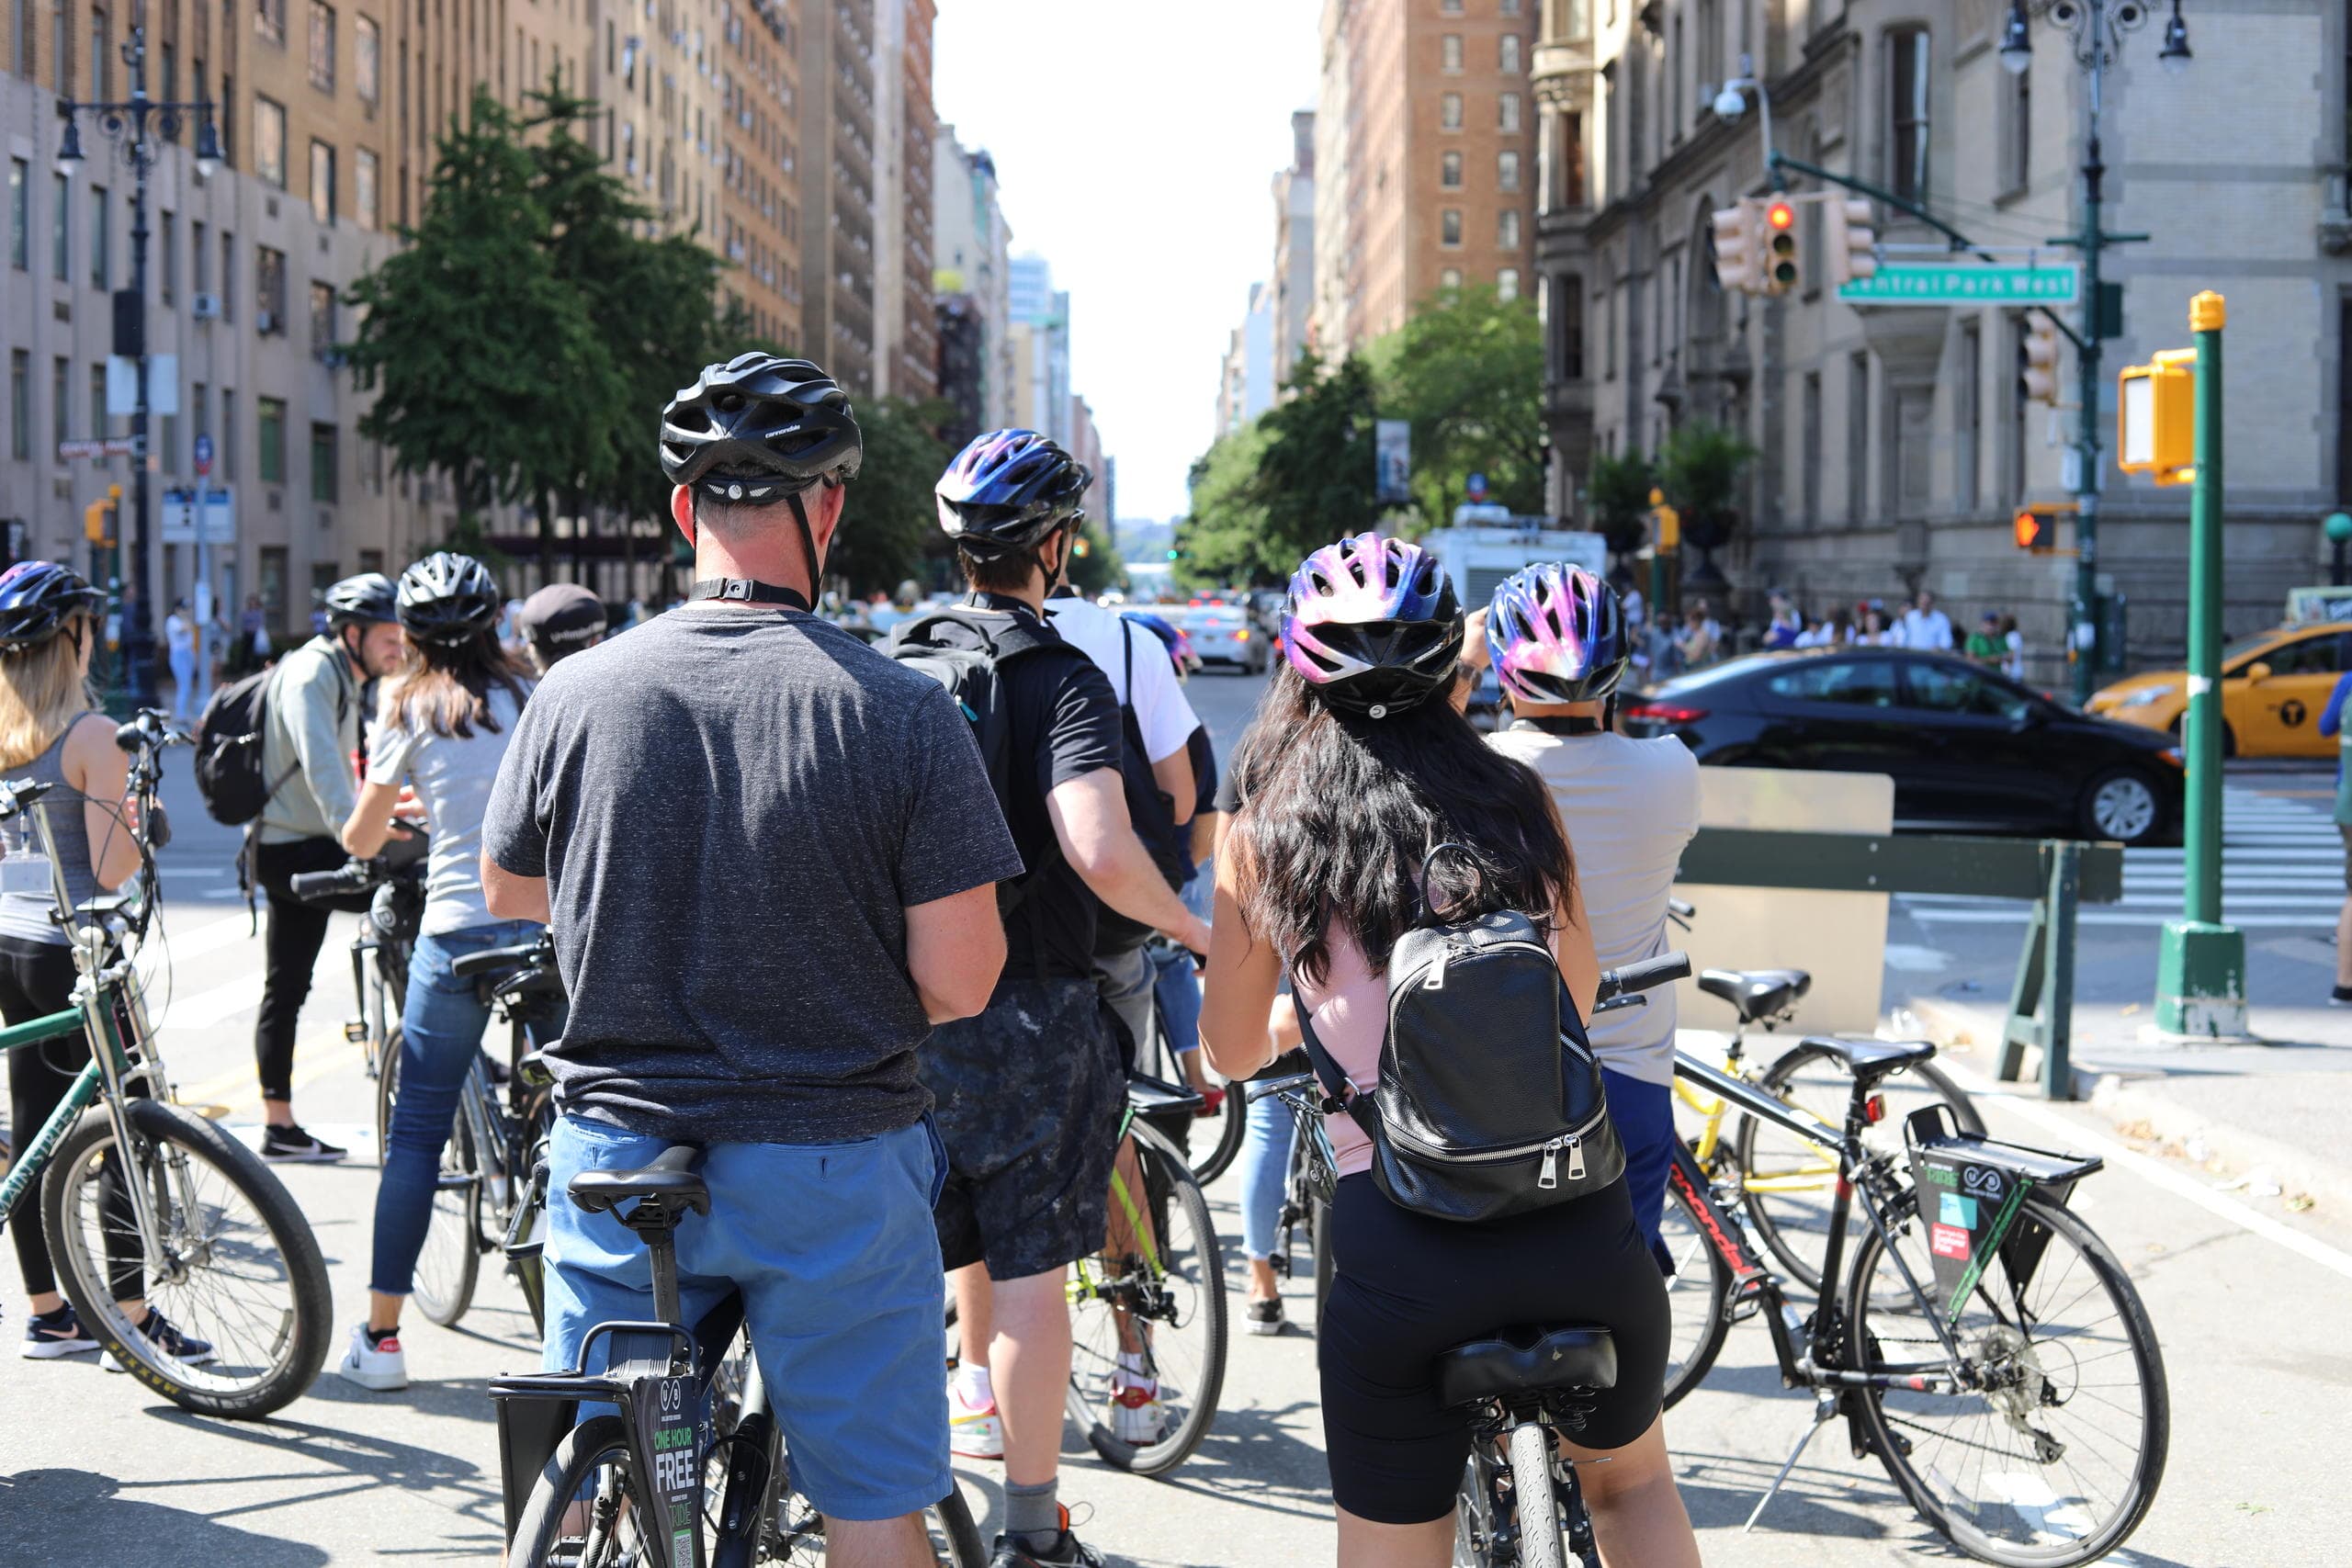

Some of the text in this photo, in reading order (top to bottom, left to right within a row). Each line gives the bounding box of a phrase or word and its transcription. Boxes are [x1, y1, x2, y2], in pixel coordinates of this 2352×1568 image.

[1847, 276, 2075, 295] entral Park West
[31, 1104, 77, 1161] STREET
[108, 1341, 180, 1395] MAXXIS
[654, 1427, 693, 1450] ONE HOUR
[655, 1449, 695, 1494] FREE
[669, 1501, 692, 1528] RIDE
